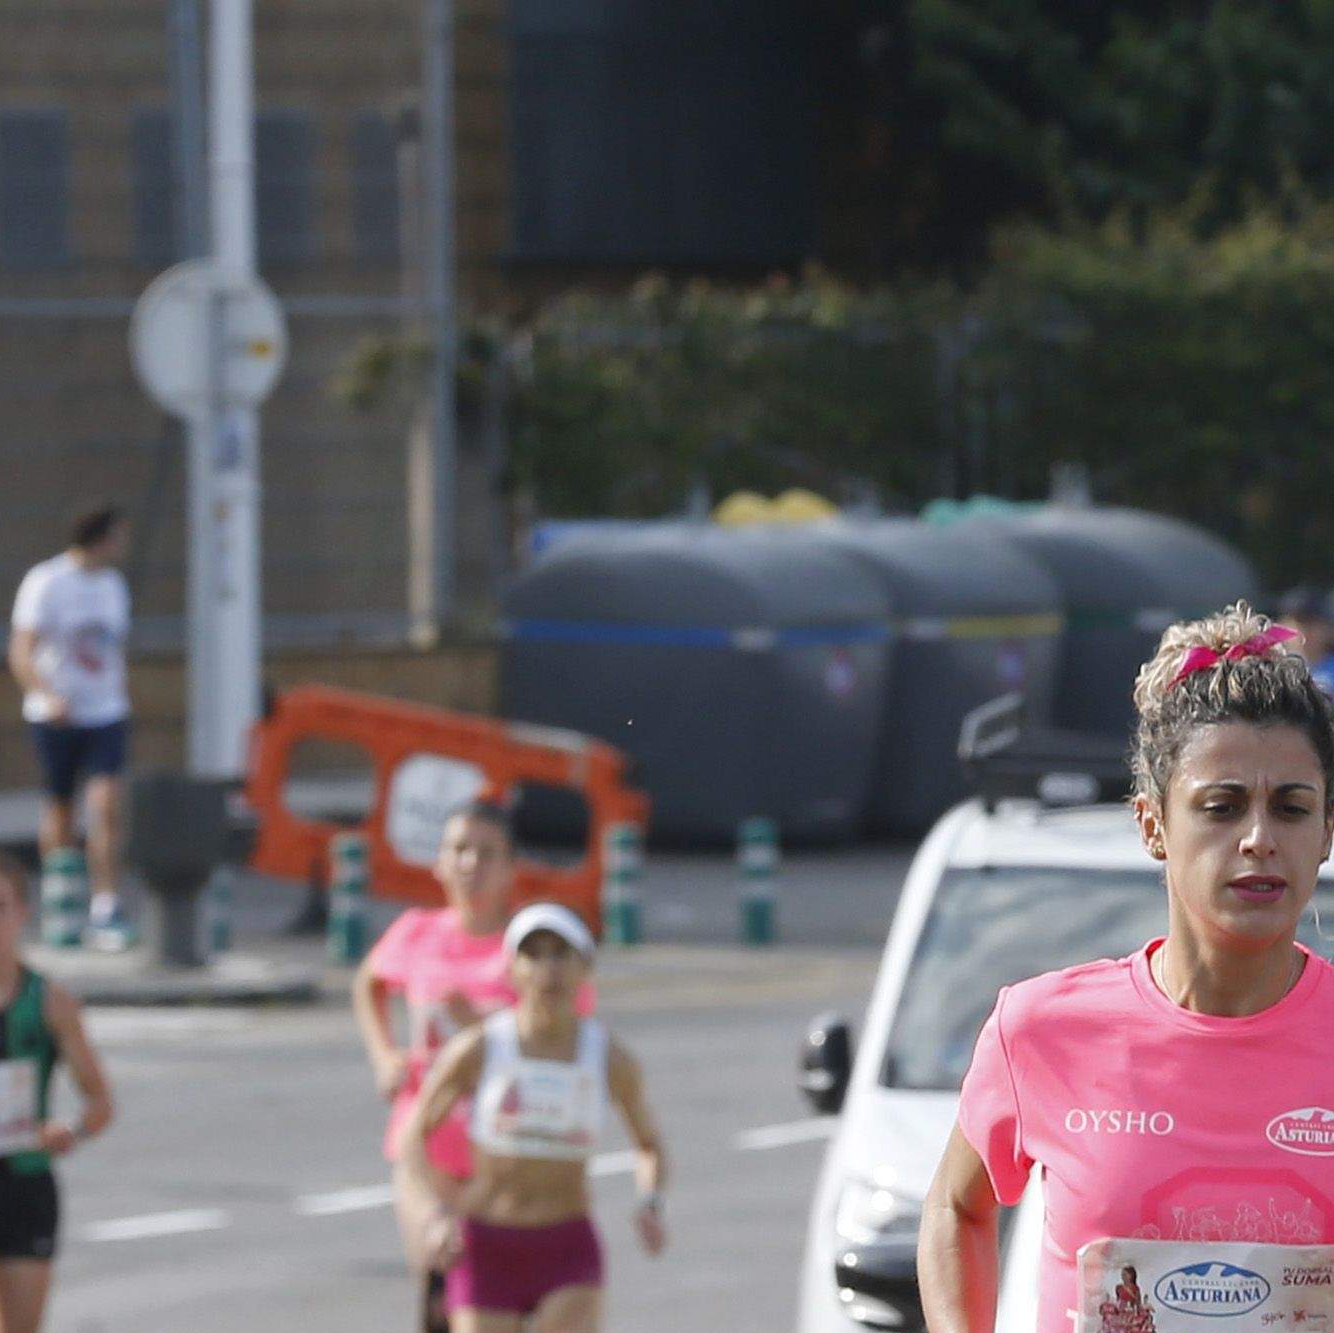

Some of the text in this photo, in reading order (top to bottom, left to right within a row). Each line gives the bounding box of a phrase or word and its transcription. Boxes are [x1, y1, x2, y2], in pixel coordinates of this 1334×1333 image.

[1065, 1108, 1174, 1136] OYSHO
[1165, 1281, 1262, 1304] ASTURIANA
[1281, 1275, 1332, 1287] SUMA
